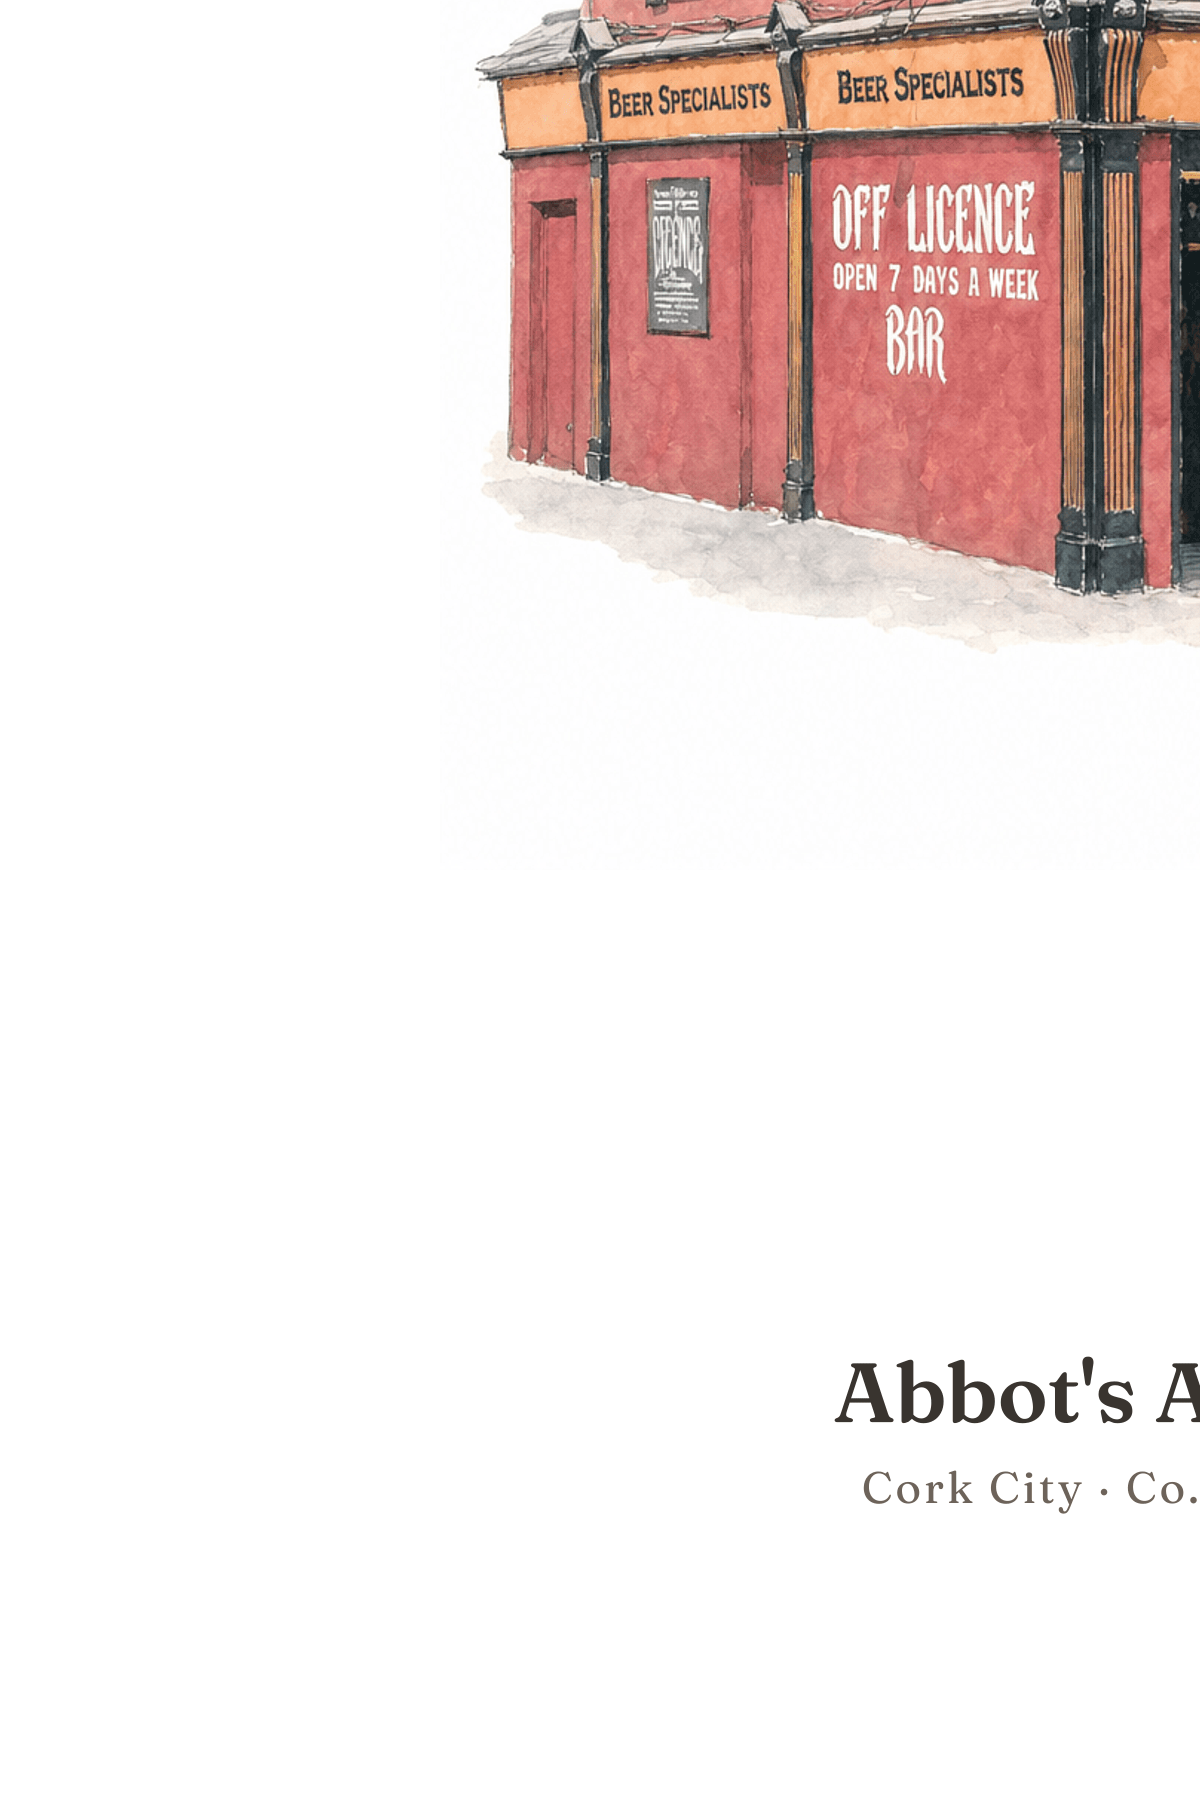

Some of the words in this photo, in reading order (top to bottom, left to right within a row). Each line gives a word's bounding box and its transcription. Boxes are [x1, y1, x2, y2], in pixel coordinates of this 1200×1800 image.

[608, 88, 654, 118] BEER
[658, 82, 771, 114] SPECIALISTS
[837, 69, 889, 104] BEER
[894, 66, 1024, 101] SPECIALISTS
[832, 183, 891, 251] OFF
[906, 180, 1036, 255] LICENCE
[833, 262, 877, 291] OPEN
[889, 263, 901, 292] 7
[913, 264, 960, 296] DAYS
[968, 266, 980, 297] A
[988, 267, 1040, 301] WEEK
[885, 304, 948, 385] BAR
